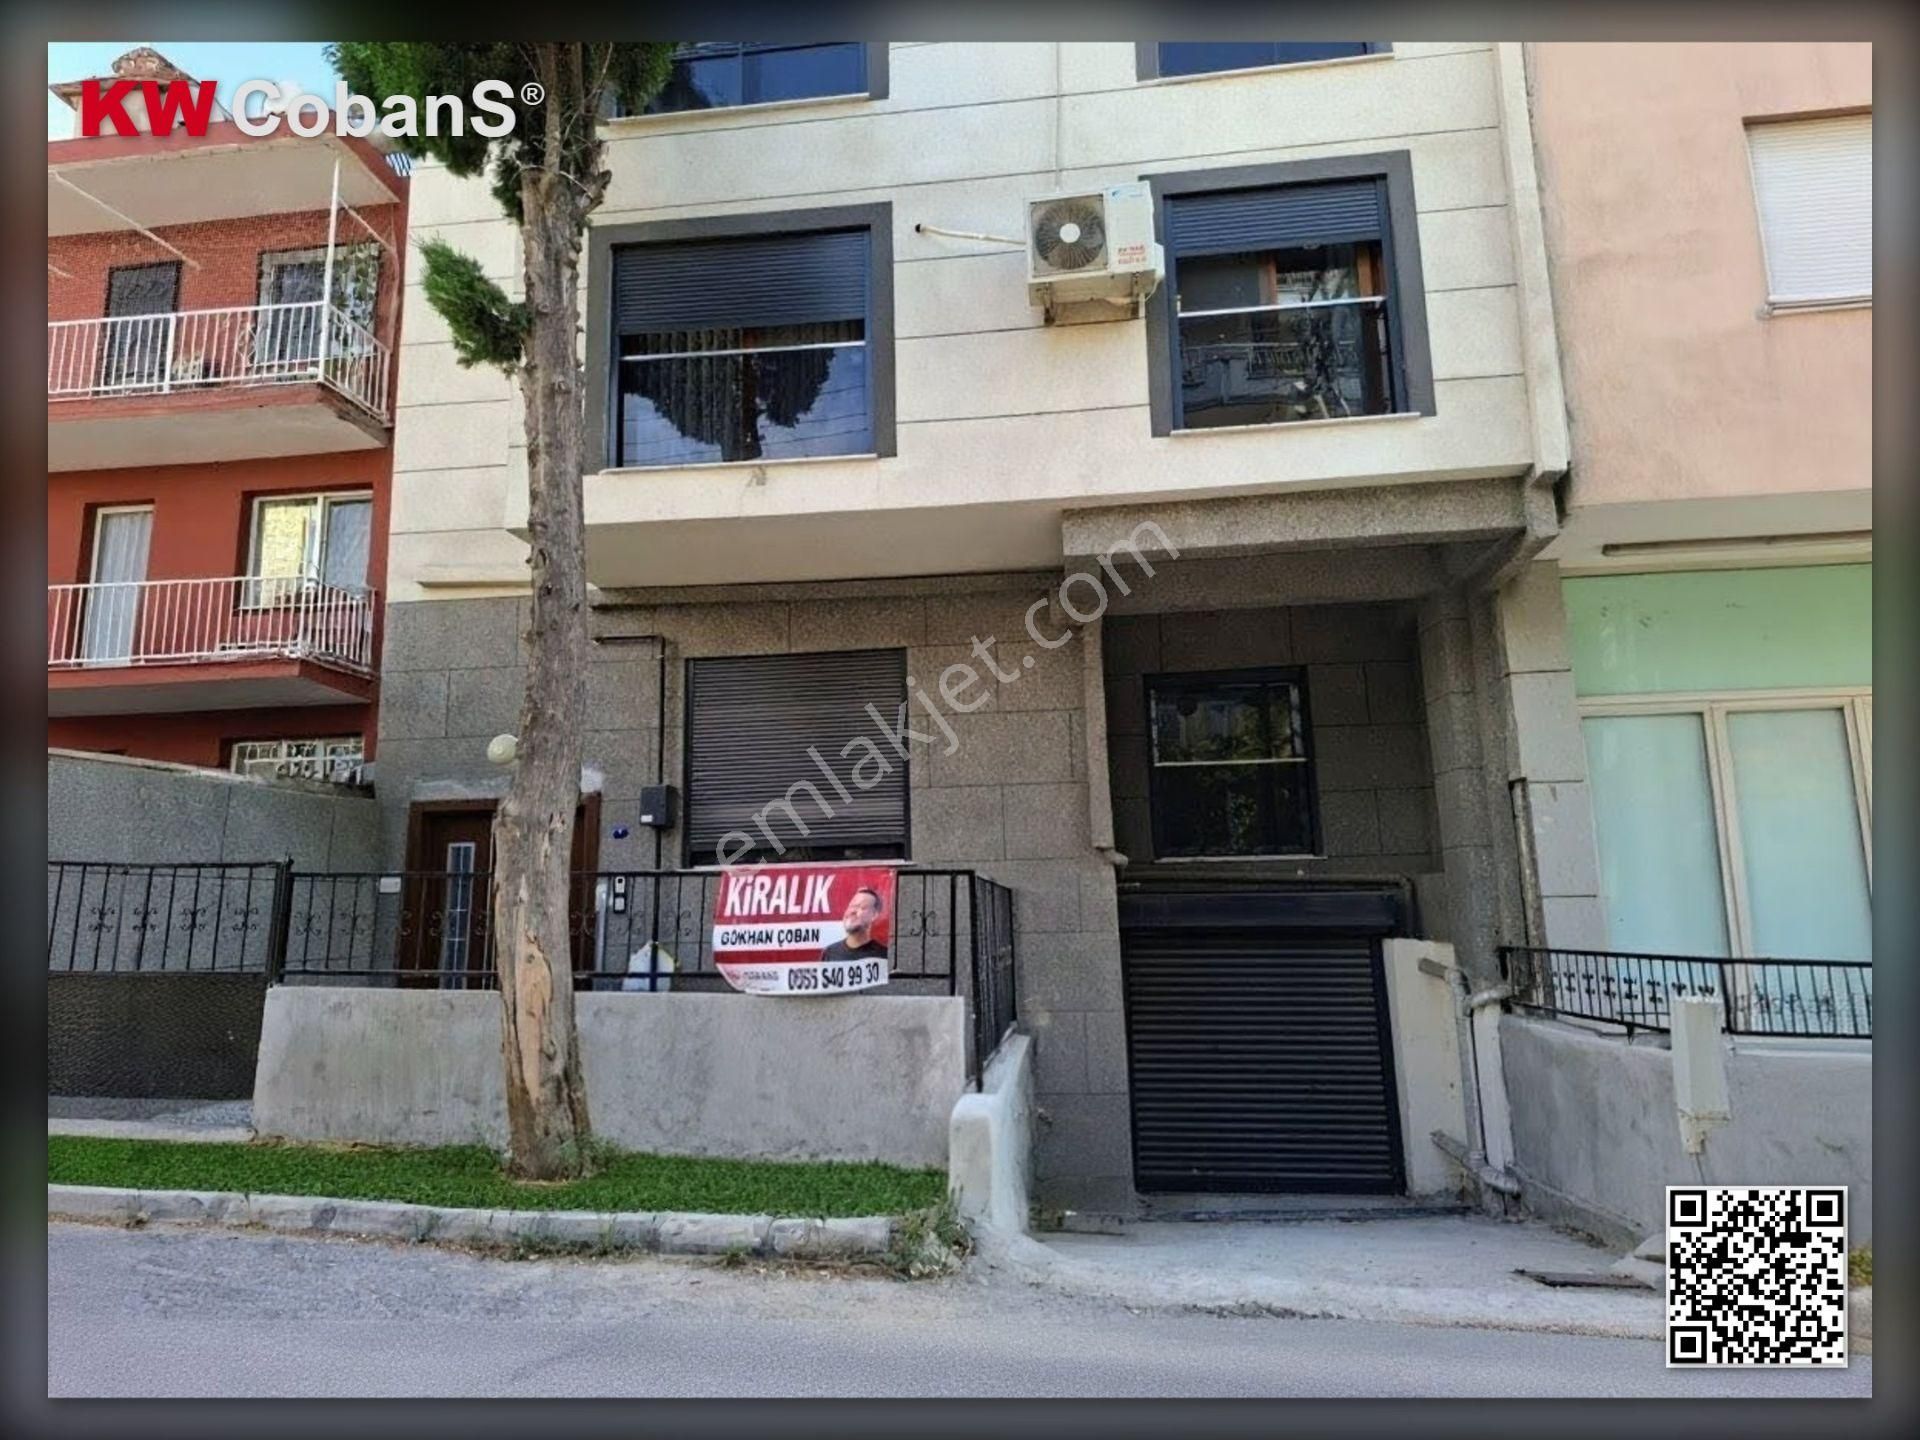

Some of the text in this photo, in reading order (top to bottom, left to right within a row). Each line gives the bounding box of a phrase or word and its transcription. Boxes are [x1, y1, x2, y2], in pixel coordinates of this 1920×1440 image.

[777, 928, 821, 947] ÇOBAN
[847, 966, 863, 985] 99
[865, 962, 880, 982] 30
